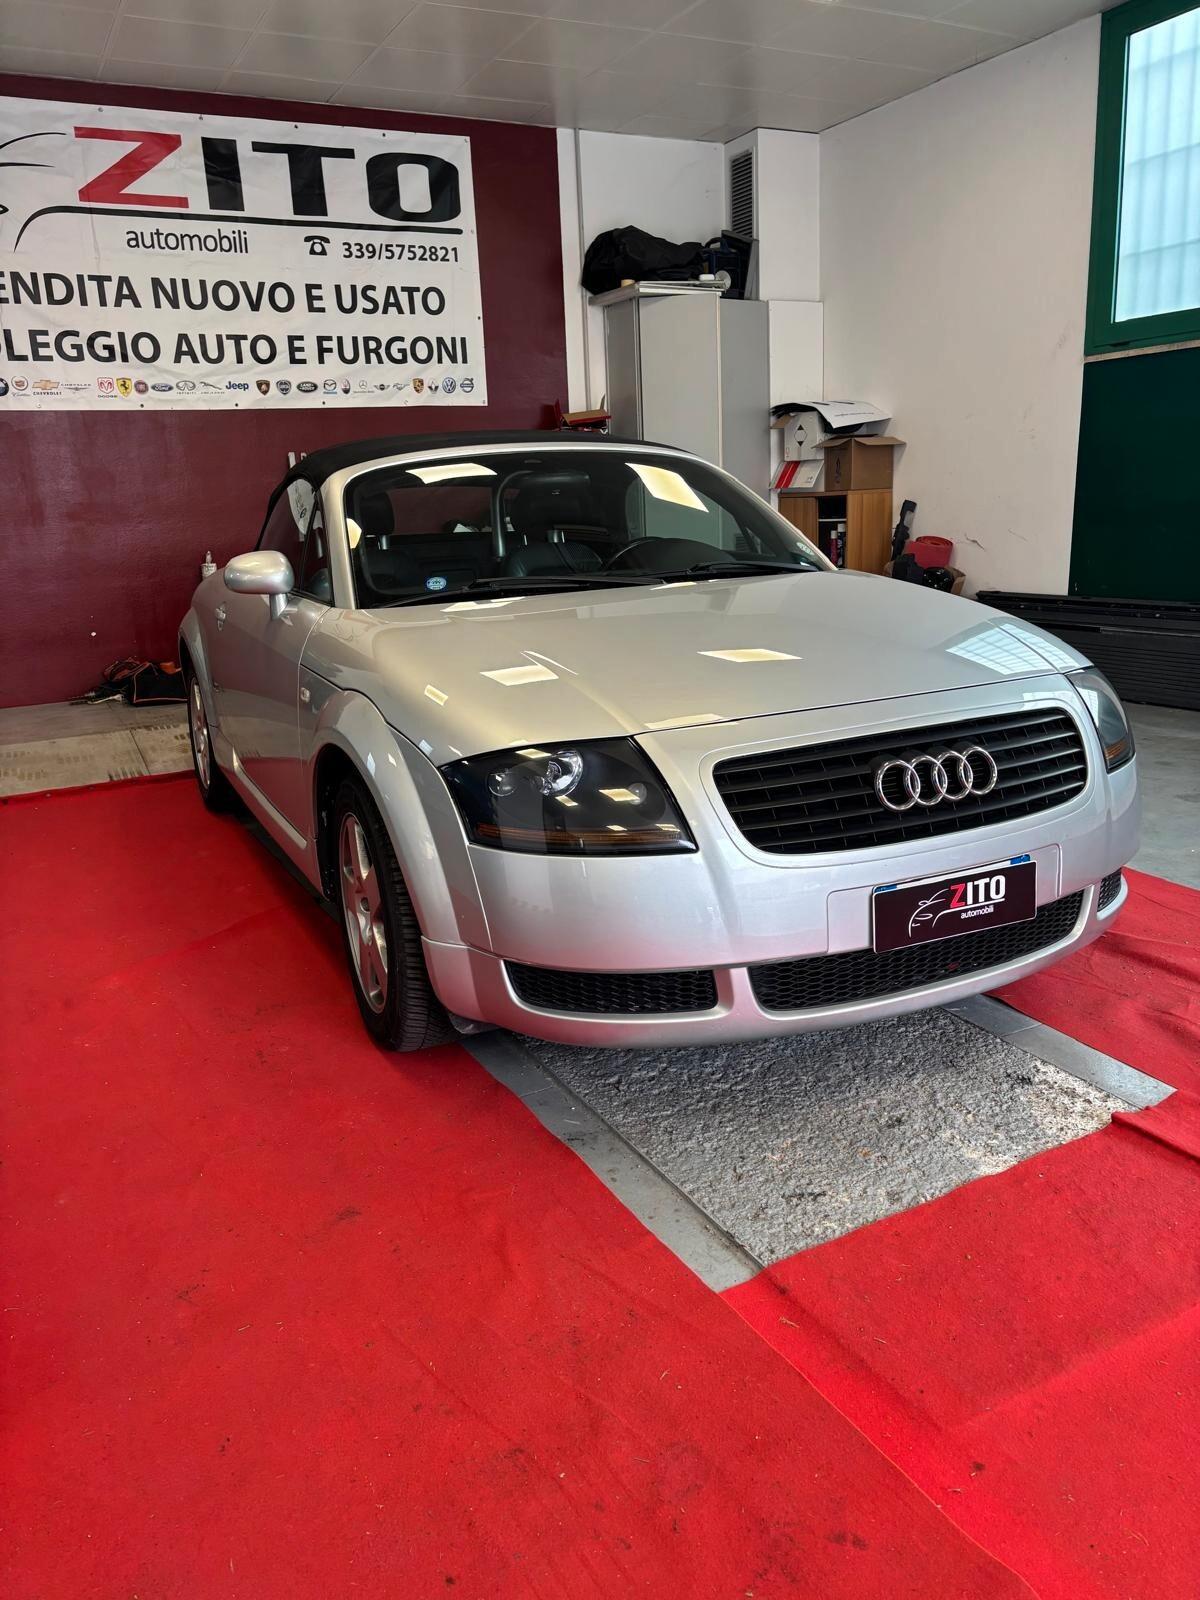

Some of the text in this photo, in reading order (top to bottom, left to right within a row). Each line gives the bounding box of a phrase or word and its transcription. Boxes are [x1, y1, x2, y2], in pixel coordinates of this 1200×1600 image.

[73, 126, 462, 223] ZITO
[126, 228, 249, 253] automobili
[342, 241, 459, 263] 339/5752821
[151, 277, 295, 314] NUOVO
[305, 284, 326, 313] E
[335, 285, 446, 315] USATO
[0, 329, 468, 365] LEGGIO AUTO E FURGONI
[225, 381, 249, 391] Jeep
[950, 875, 1006, 909] ZITO
[960, 905, 995, 919] automobili
